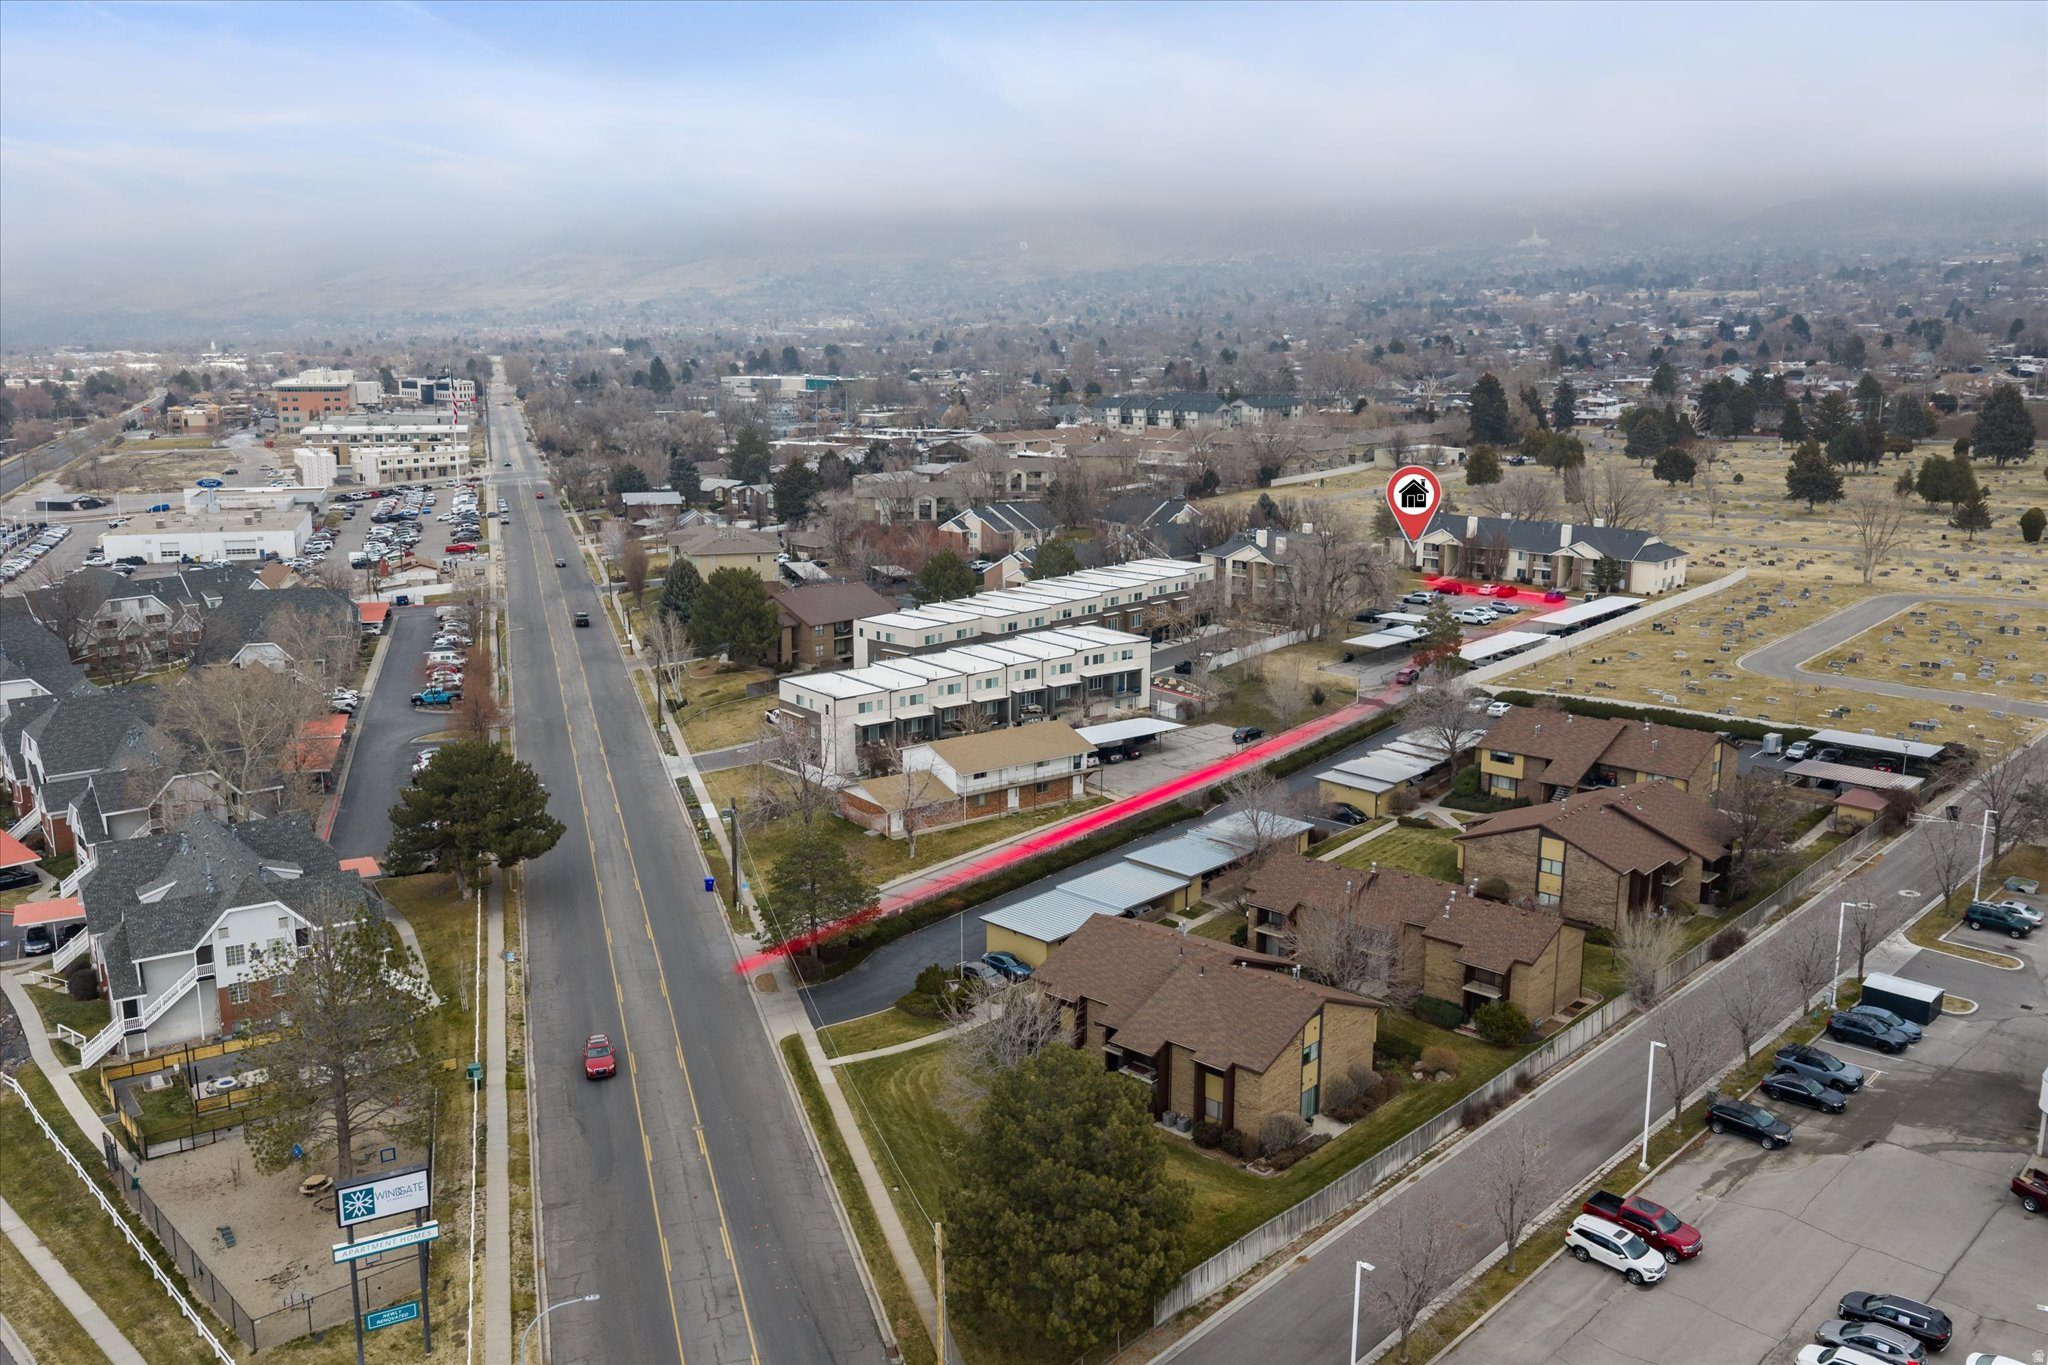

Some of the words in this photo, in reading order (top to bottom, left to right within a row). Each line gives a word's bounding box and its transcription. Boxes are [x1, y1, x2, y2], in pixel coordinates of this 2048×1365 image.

[375, 1181, 424, 1200] WINDGATE
[342, 1239, 396, 1257] APARTMENT
[400, 1231, 431, 1242] HOMES
[376, 1312, 408, 1324] RENOVATED
[382, 1310, 402, 1318] NEWLY
